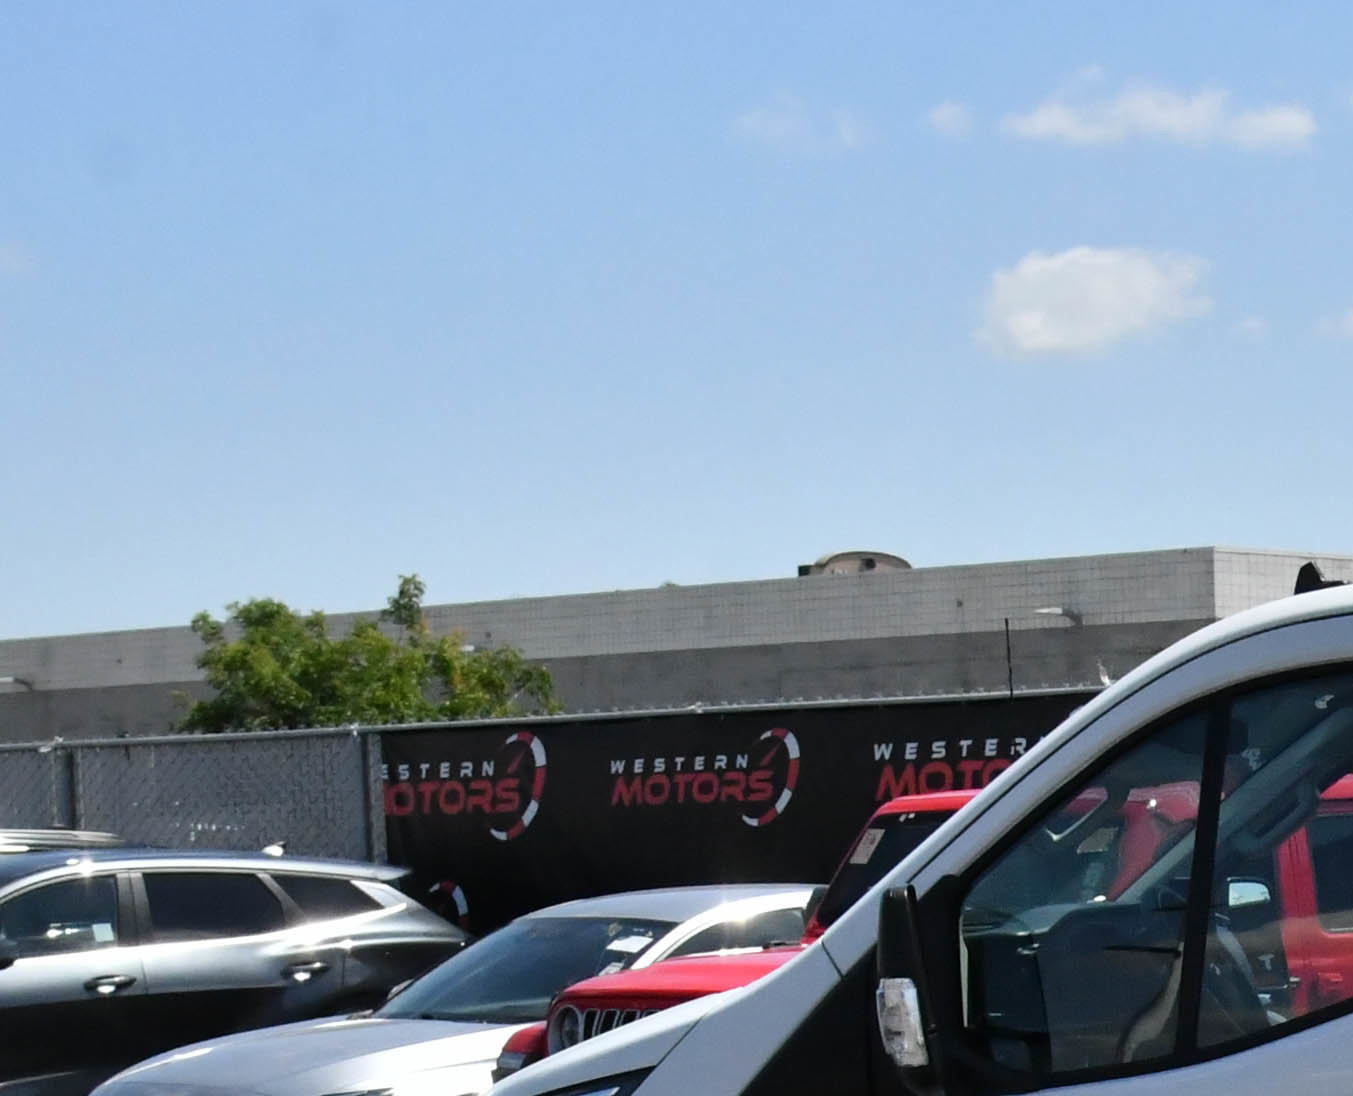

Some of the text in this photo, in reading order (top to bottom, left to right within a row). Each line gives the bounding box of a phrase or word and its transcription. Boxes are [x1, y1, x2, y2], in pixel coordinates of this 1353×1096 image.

[874, 736, 1046, 761] WESTER
[381, 760, 495, 780] ESTERN
[610, 754, 749, 774] WESTERN
[384, 777, 520, 816] OTORS
[611, 770, 774, 807] MOTORS
